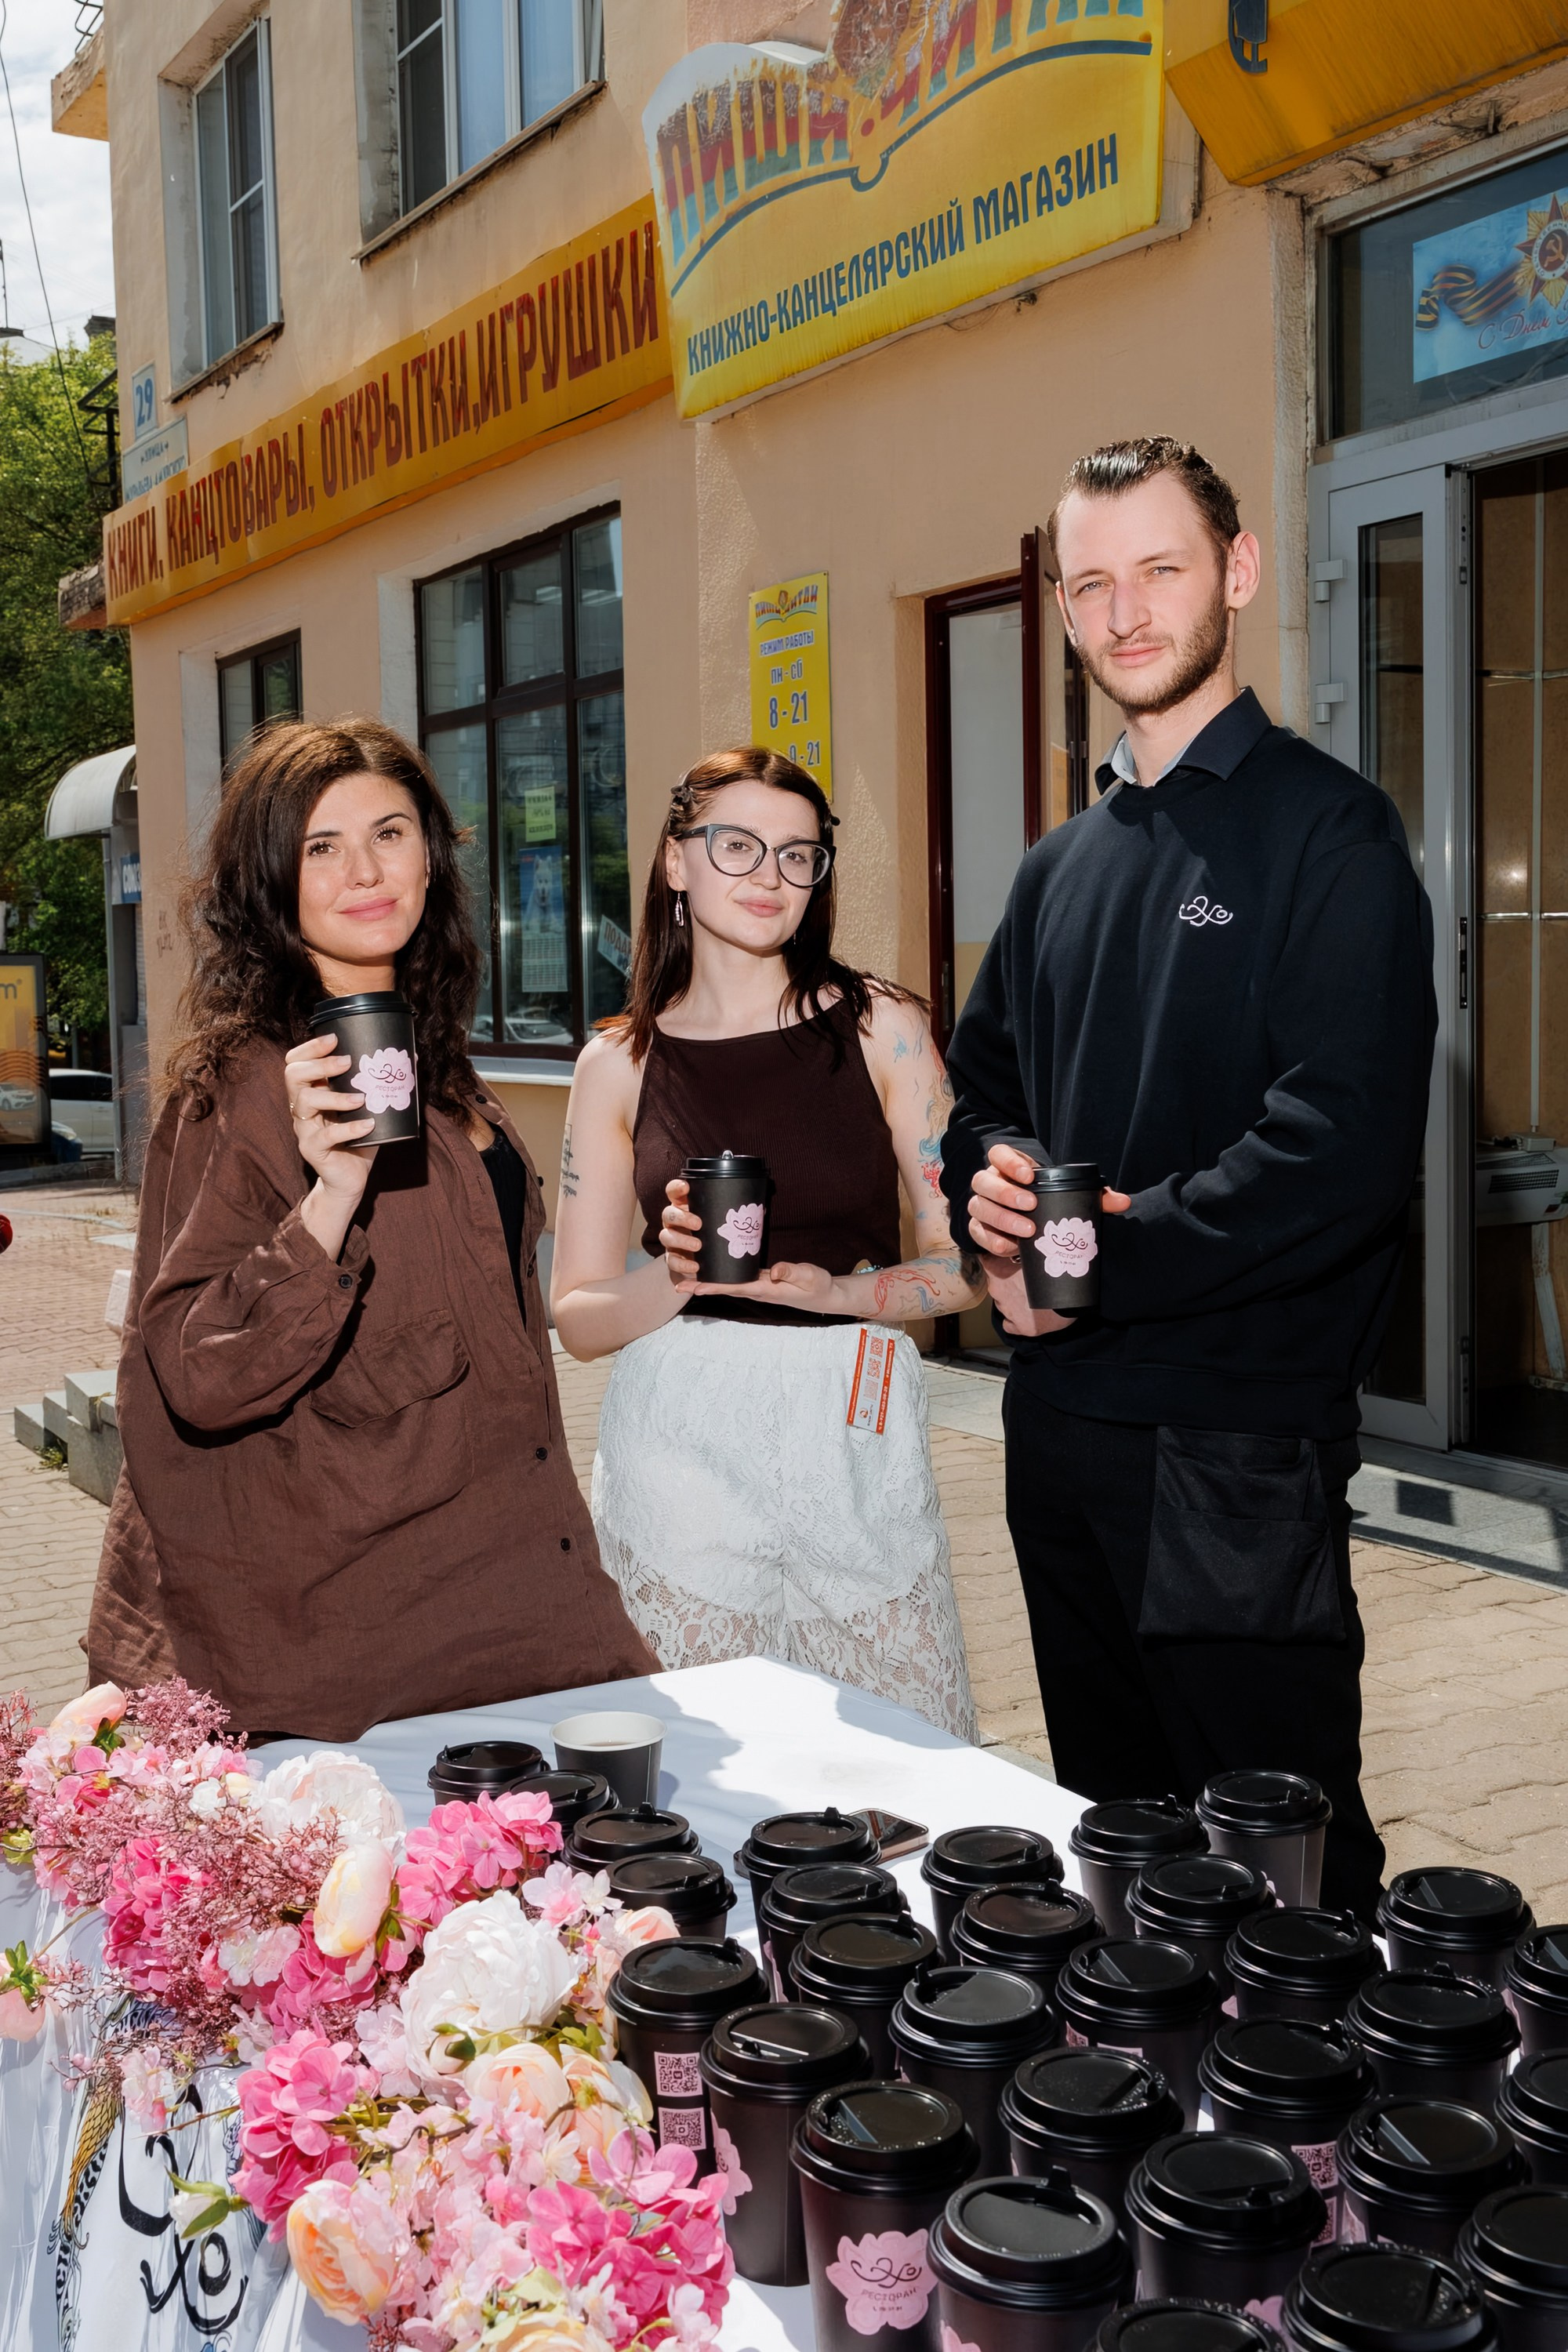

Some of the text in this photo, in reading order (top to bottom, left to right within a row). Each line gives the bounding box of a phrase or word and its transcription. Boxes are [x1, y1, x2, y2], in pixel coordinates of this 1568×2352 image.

[687, 132, 1119, 376] КНИЖНО-КАНЦЕЛЯРСКИЙ МАГАЗИН
[1499, 309, 1550, 340] Днем
[135, 378, 154, 427] 29
[107, 505, 164, 601] КНИГИ,
[166, 421, 315, 572] КАНЦТОВАРЫ,
[760, 630, 814, 655] РЕЖИМ РАБОТЫ
[770, 697, 779, 728] 8
[791, 691, 808, 724] 21
[808, 741, 821, 766] 21
[861, 2287, 917, 2302] РЕСТОРАН
